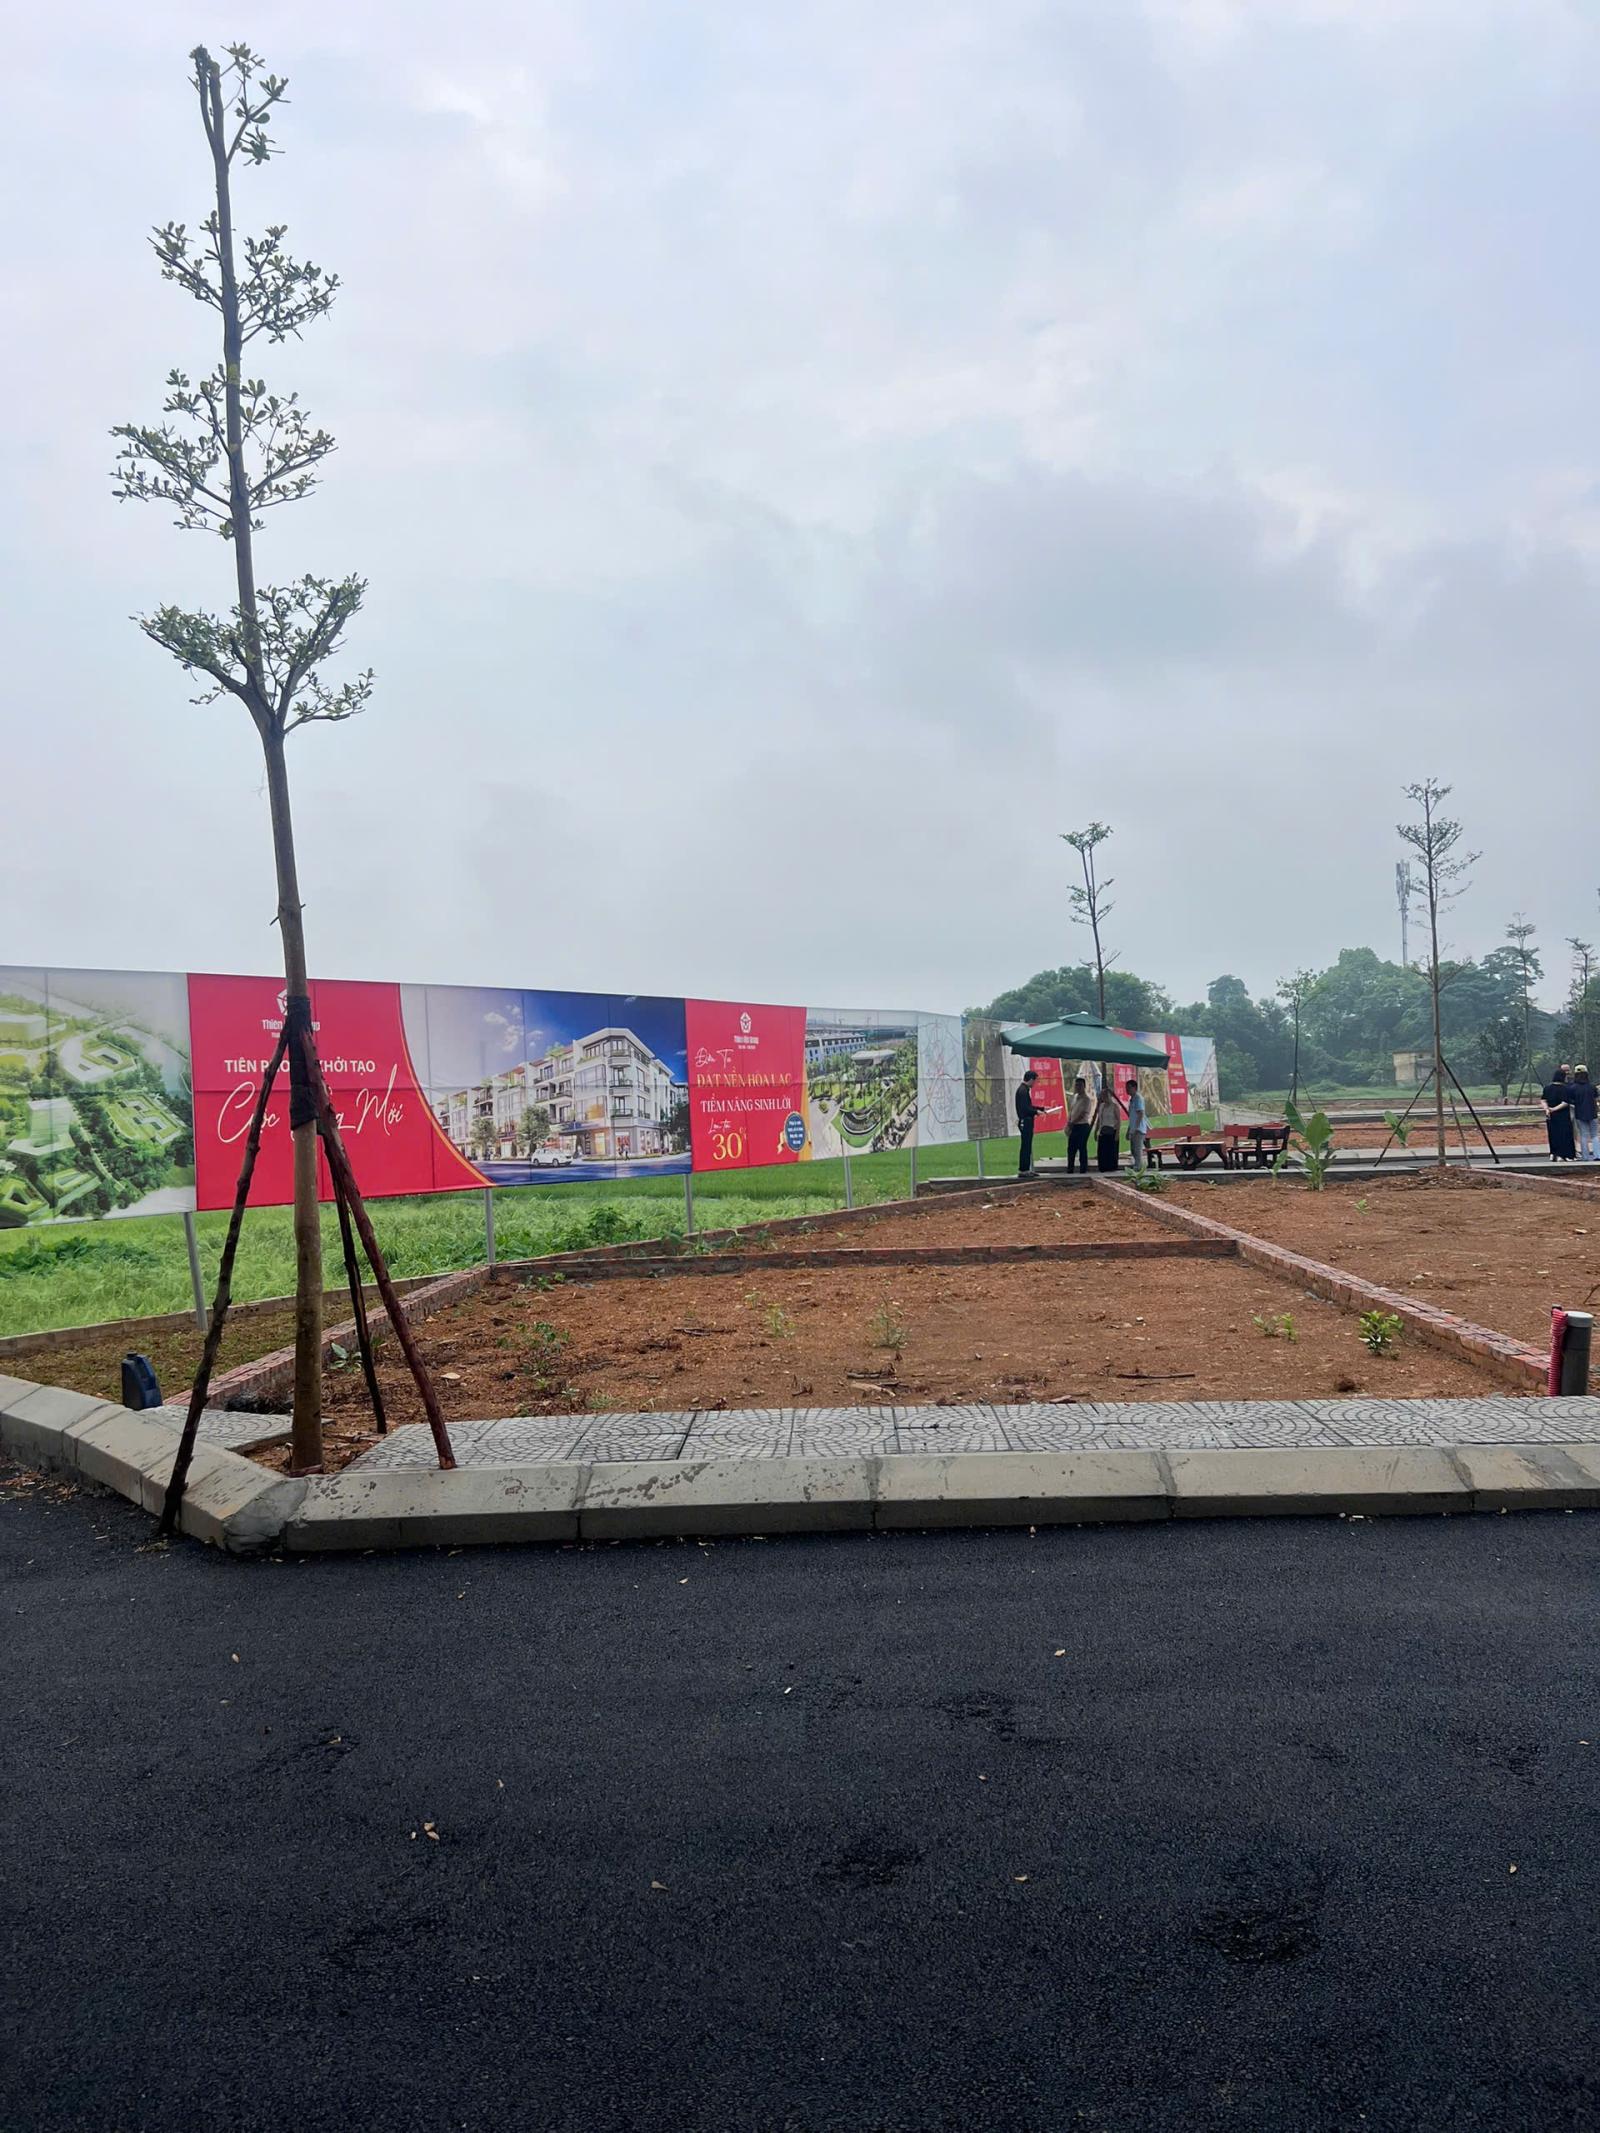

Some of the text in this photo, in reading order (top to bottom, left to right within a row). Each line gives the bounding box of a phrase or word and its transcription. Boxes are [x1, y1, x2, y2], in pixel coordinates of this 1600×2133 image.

[224, 1056, 257, 1073] TIÊN
[350, 1060, 376, 1076] TẠO
[217, 1081, 280, 1143] Cộc
[356, 1063, 404, 1137] Mới
[754, 1098, 776, 1111] SINH
